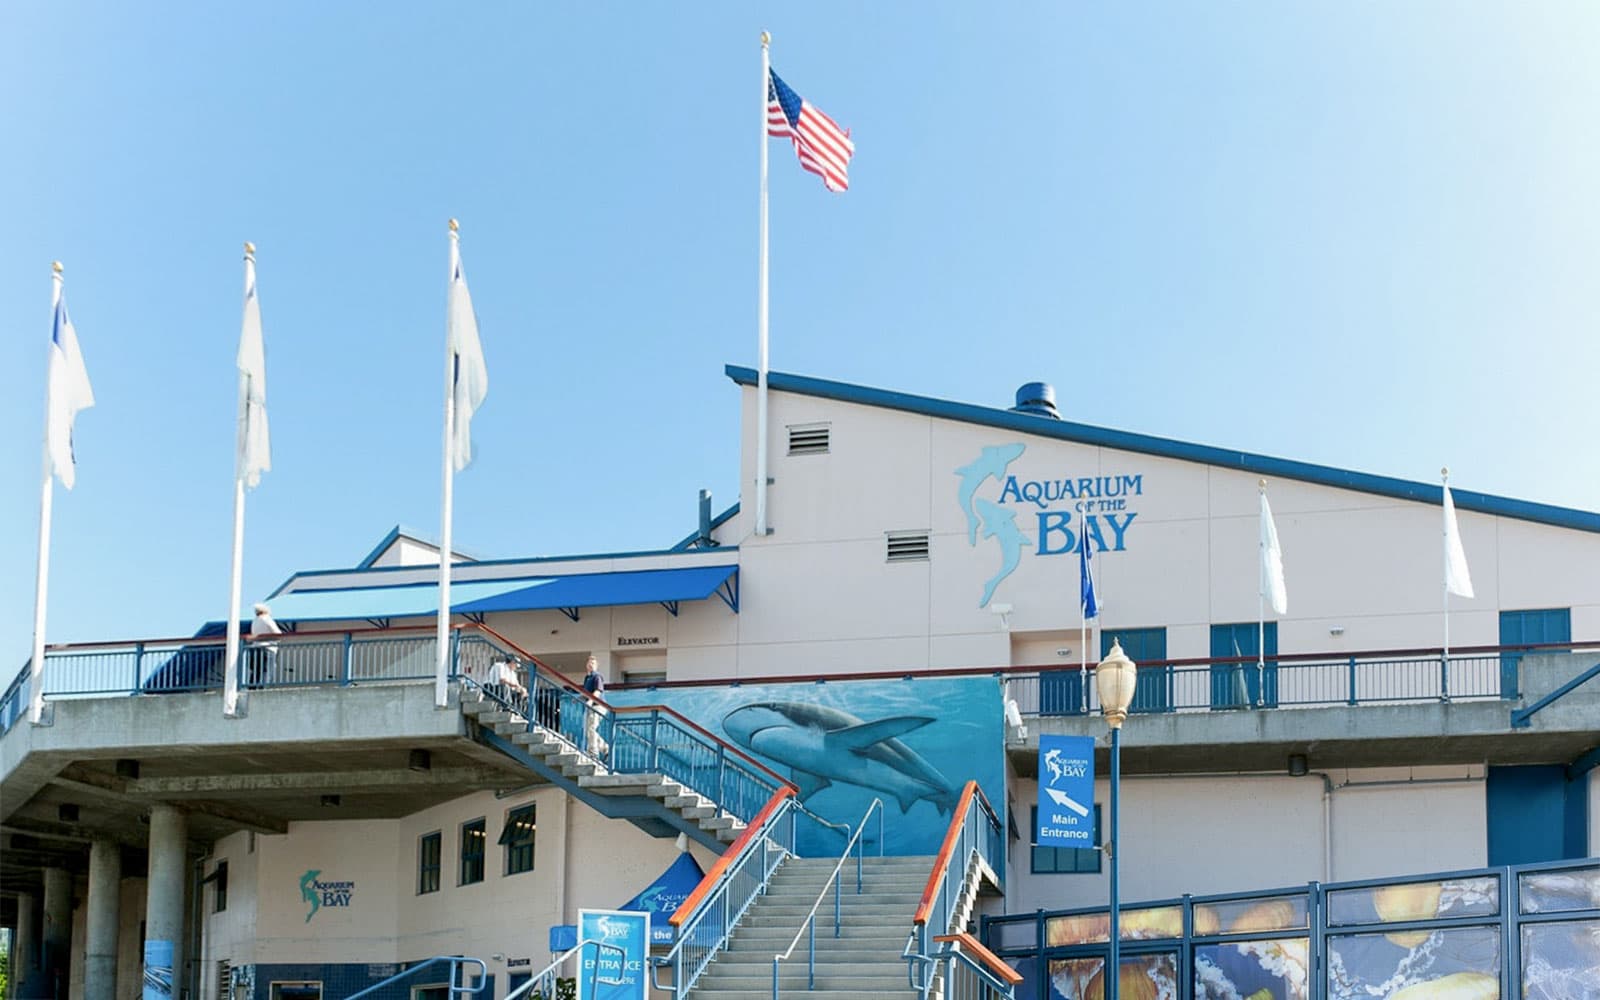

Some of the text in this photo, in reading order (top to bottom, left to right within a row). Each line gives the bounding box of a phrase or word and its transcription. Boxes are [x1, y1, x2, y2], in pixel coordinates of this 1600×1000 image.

[998, 474, 1143, 508] AQUARIUM
[1076, 499, 1126, 513] OF THE
[1035, 511, 1138, 555] BAY
[617, 637, 659, 646] ELEVATOR
[1063, 766, 1086, 777] BAY
[1052, 814, 1078, 825] Main
[1041, 828, 1088, 838] Entrance
[322, 892, 352, 906] BAY
[654, 930, 672, 940] the
